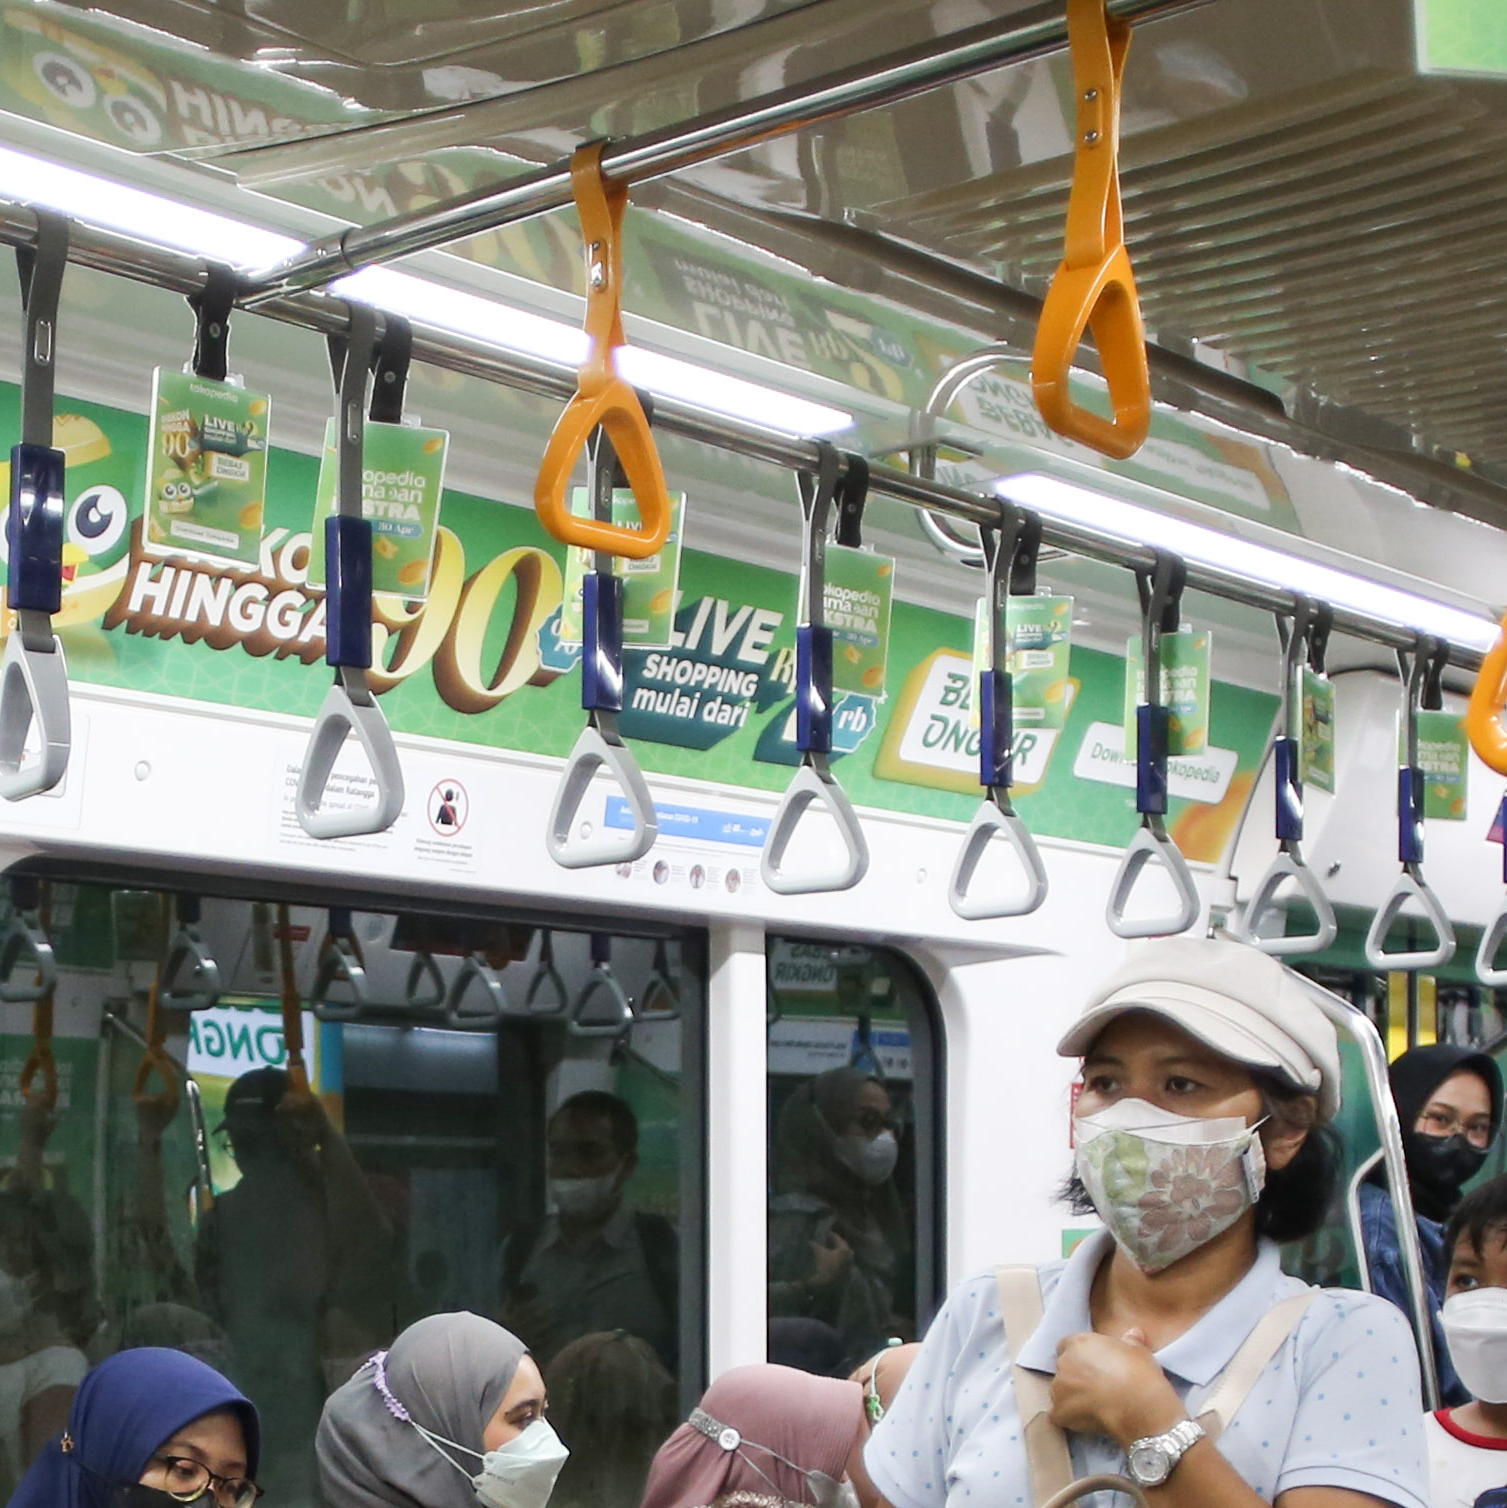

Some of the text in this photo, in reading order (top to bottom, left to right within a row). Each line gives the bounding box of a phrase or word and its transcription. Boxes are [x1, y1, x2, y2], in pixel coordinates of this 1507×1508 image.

[189, 383, 239, 403] tokopedia
[204, 414, 236, 433] LIVE
[162, 432, 190, 458] 90
[363, 467, 426, 489] opedia
[363, 499, 420, 522] STRA
[129, 561, 327, 645] HINGGA
[672, 590, 784, 665] LIVE
[1016, 623, 1042, 634] LIVE
[642, 653, 759, 698] SHOPPING
[632, 687, 750, 728] mulai dari
[838, 708, 867, 733] rb
